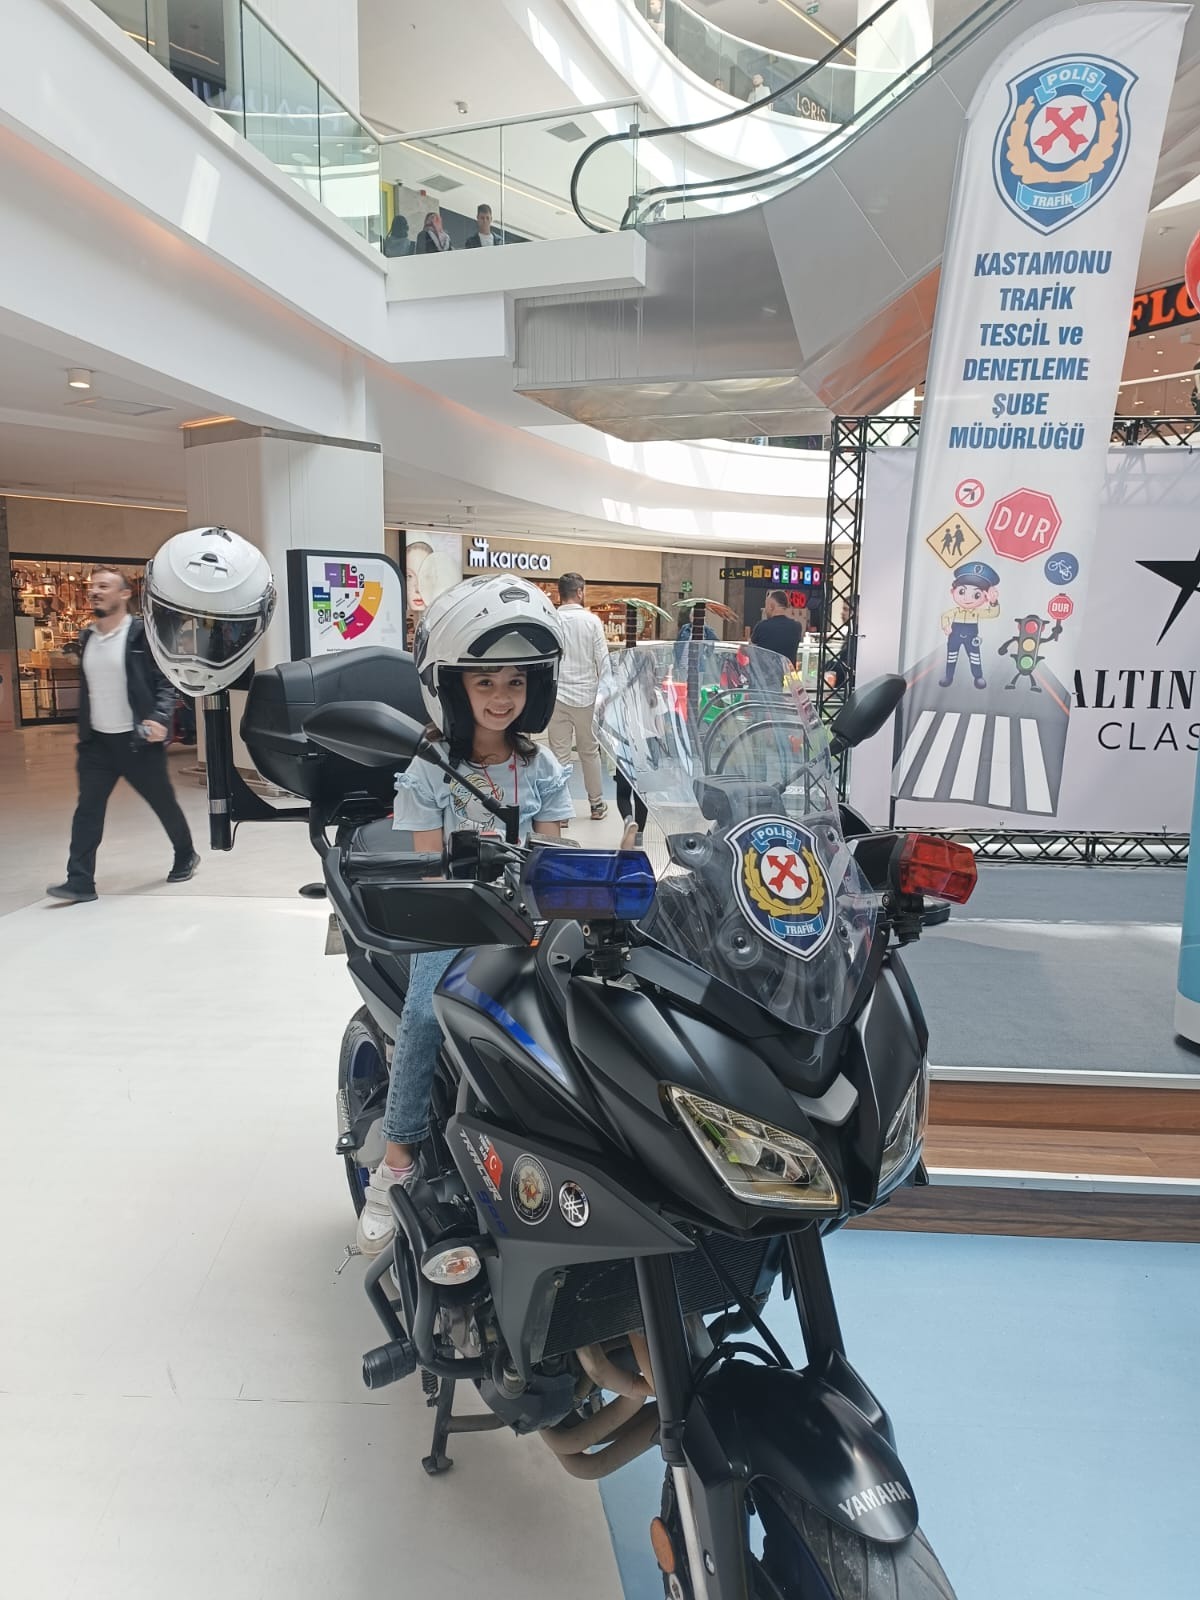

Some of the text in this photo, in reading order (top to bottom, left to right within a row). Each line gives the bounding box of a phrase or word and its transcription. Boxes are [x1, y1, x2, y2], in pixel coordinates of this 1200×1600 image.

[1046, 67, 1098, 86] POLİS
[797, 92, 826, 122] LORIS
[1032, 193, 1073, 207] TRAFİK
[974, 250, 1112, 276] KASTAMONU
[1000, 282, 1075, 311] TRAFİK
[980, 318, 1083, 346] TESCİL ve
[963, 358, 1090, 381] DENETLEME
[992, 393, 1049, 418] ŞUBE
[949, 422, 1085, 449] MÜDÜRLÜĞÜ
[993, 506, 1051, 544] DUR
[490, 552, 551, 571] karaca
[1051, 603, 1070, 613] DUR
[757, 827, 793, 840] POLİS
[785, 922, 815, 935] TRAFİK
[460, 1128, 502, 1201] TRACER
[838, 1481, 911, 1521] YAMAHA
